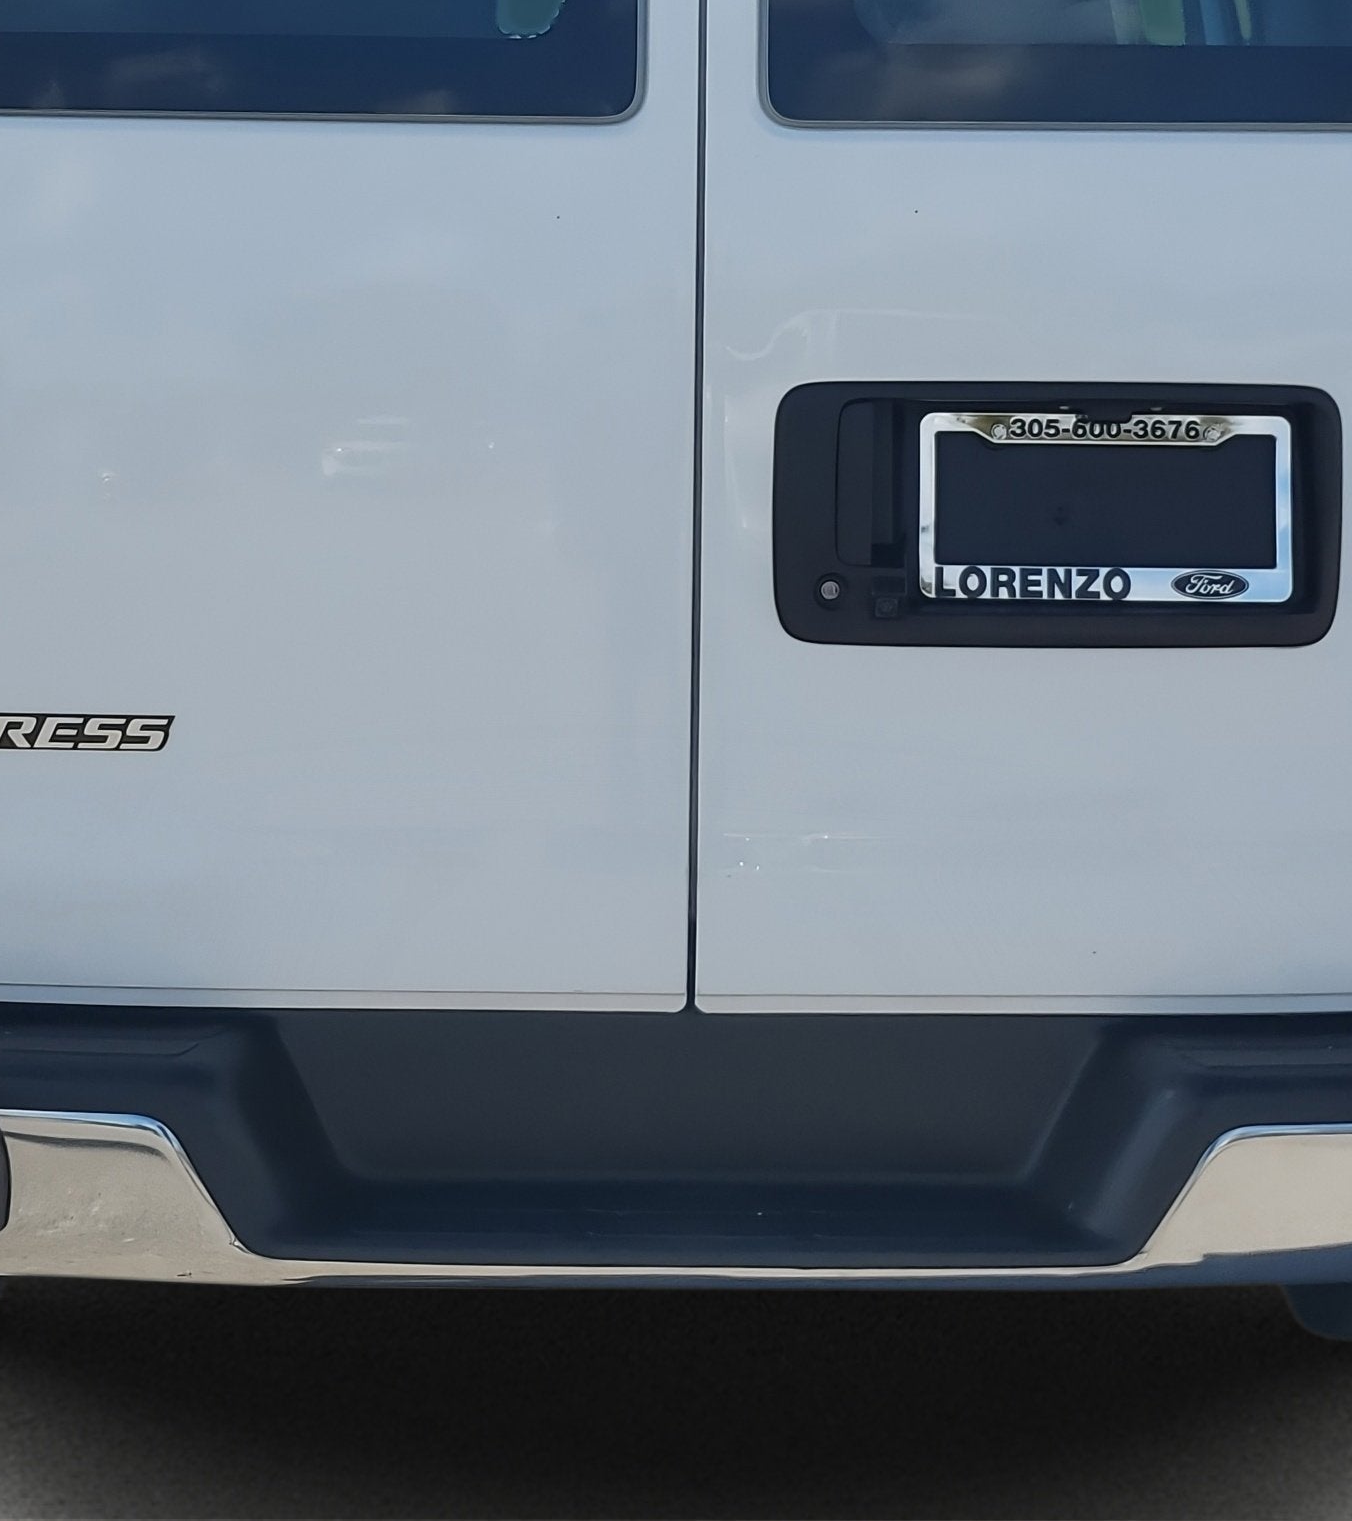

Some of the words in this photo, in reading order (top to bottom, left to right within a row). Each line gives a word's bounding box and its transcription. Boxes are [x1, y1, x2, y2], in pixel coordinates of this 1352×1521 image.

[1010, 417, 1200, 440] 305-600-3676
[934, 565, 1132, 601] LORENZO
[1185, 574, 1236, 595] Ford
